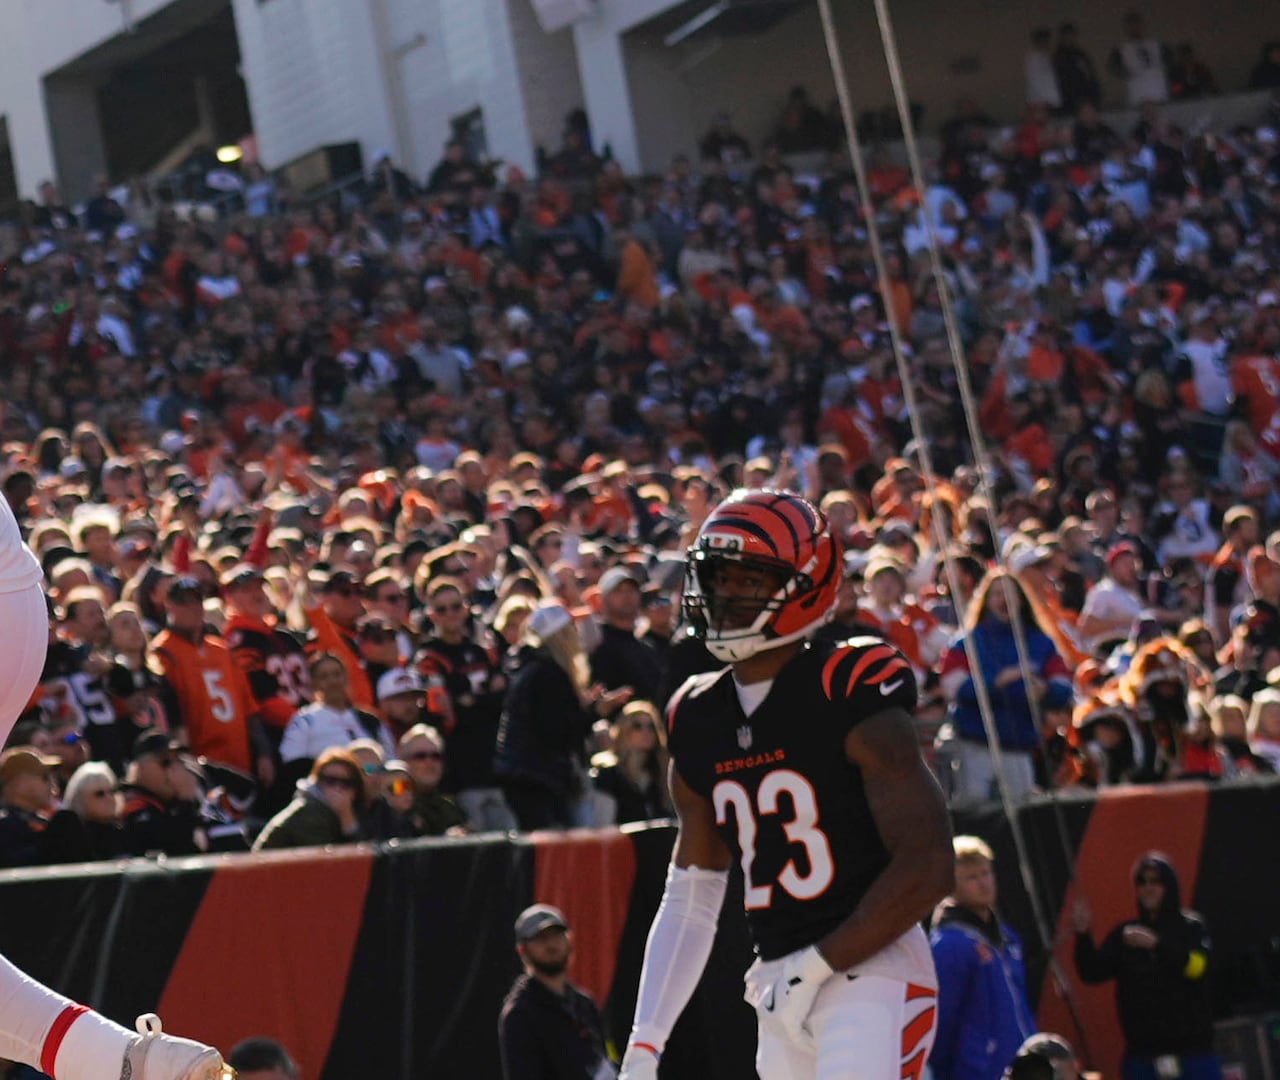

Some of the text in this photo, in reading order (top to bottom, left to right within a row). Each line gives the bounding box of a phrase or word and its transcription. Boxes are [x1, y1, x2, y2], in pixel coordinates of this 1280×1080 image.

[201, 669, 236, 723] 5
[714, 748, 786, 775] BENGALS
[711, 768, 837, 912] 23
